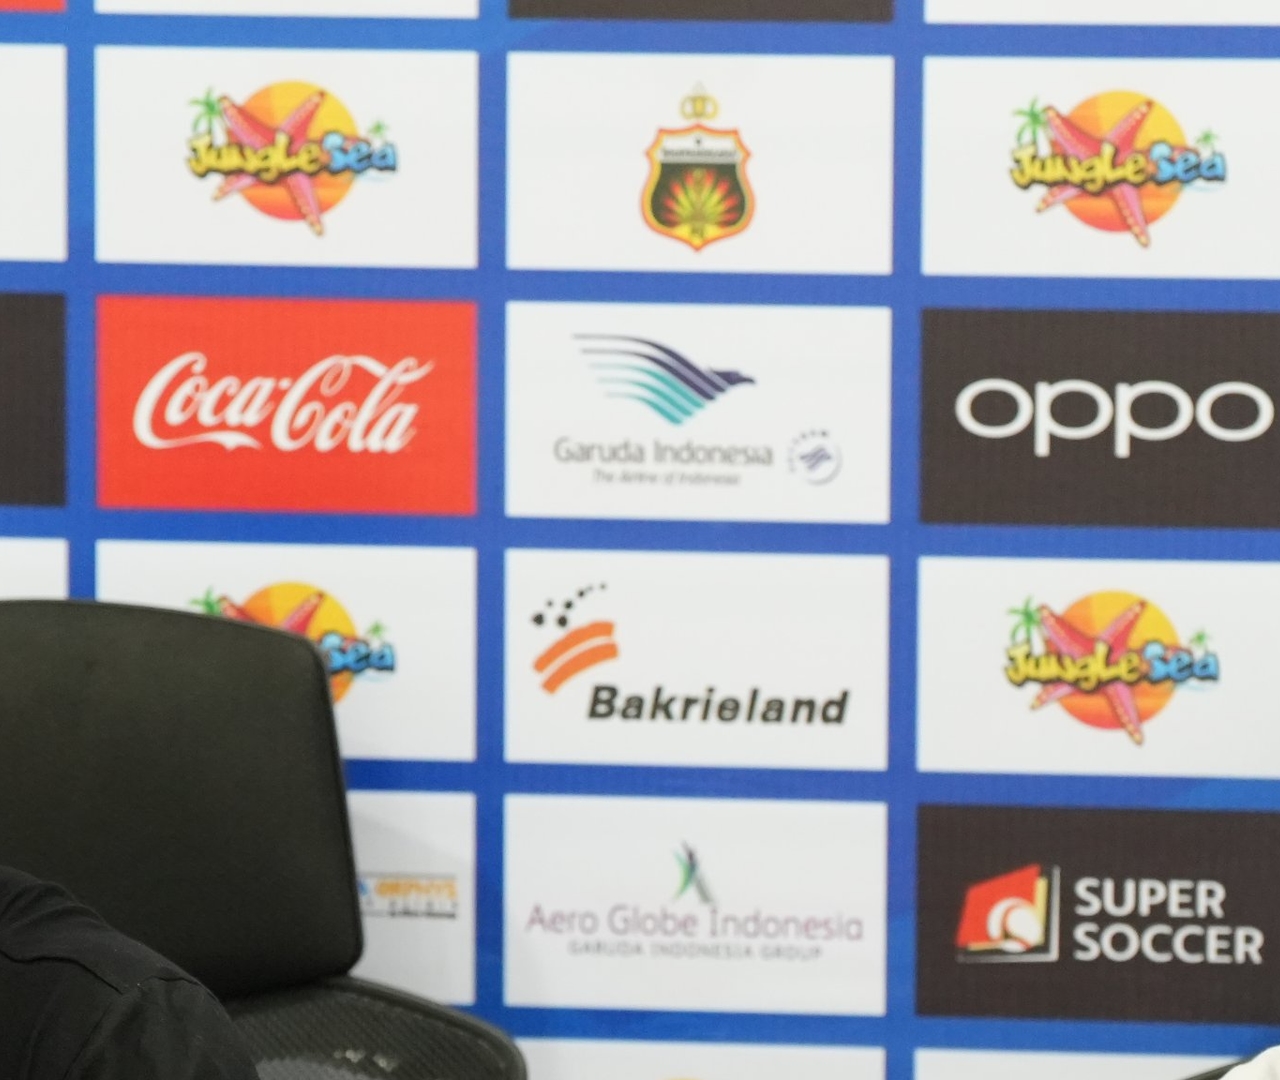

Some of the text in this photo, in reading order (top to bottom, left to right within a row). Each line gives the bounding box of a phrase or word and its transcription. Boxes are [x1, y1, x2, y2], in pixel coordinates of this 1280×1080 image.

[321, 127, 398, 175] Sea
[1148, 141, 1227, 185] Sea
[133, 352, 434, 453] Coca-Cola
[554, 437, 645, 464] Garuda
[653, 440, 773, 467] Indonesia
[1141, 637, 1221, 684] Sea
[587, 685, 850, 727] Bakrieland
[1074, 876, 1227, 919] SUPER
[524, 903, 865, 942] Aero Globe Indonesia
[567, 940, 823, 961] GARUDA INDONESIA GROUP
[1073, 923, 1264, 966] SOCCER
